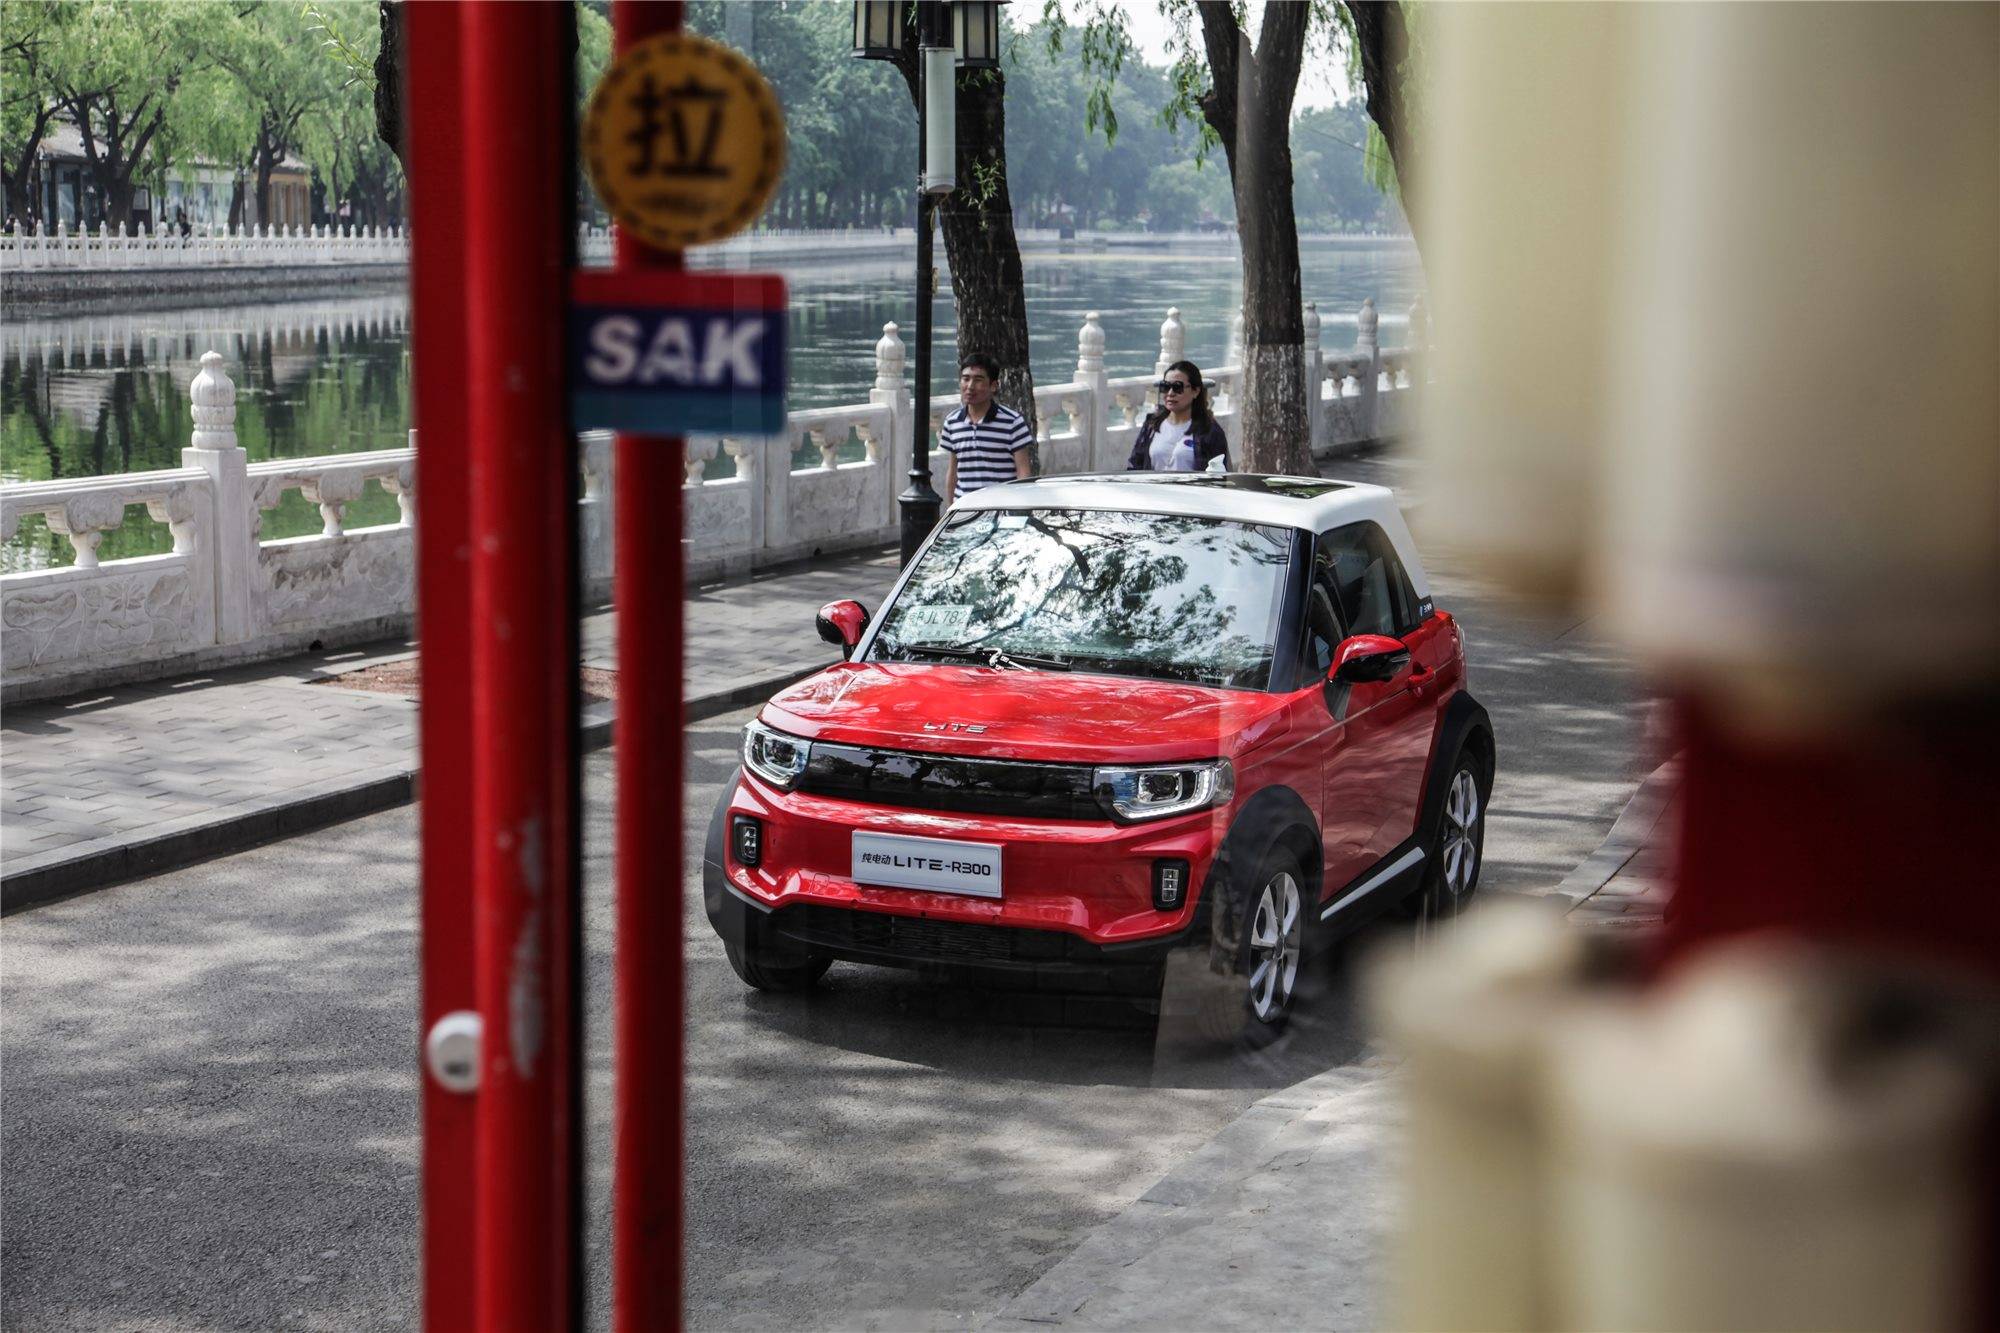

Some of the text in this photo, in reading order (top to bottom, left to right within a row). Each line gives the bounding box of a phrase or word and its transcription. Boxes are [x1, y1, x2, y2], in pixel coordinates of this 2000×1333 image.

[627, 74, 730, 180] 拉
[586, 316, 765, 385] SAK
[923, 721, 988, 734] LITE
[862, 853, 991, 876] 纯电动 LITE-R300
